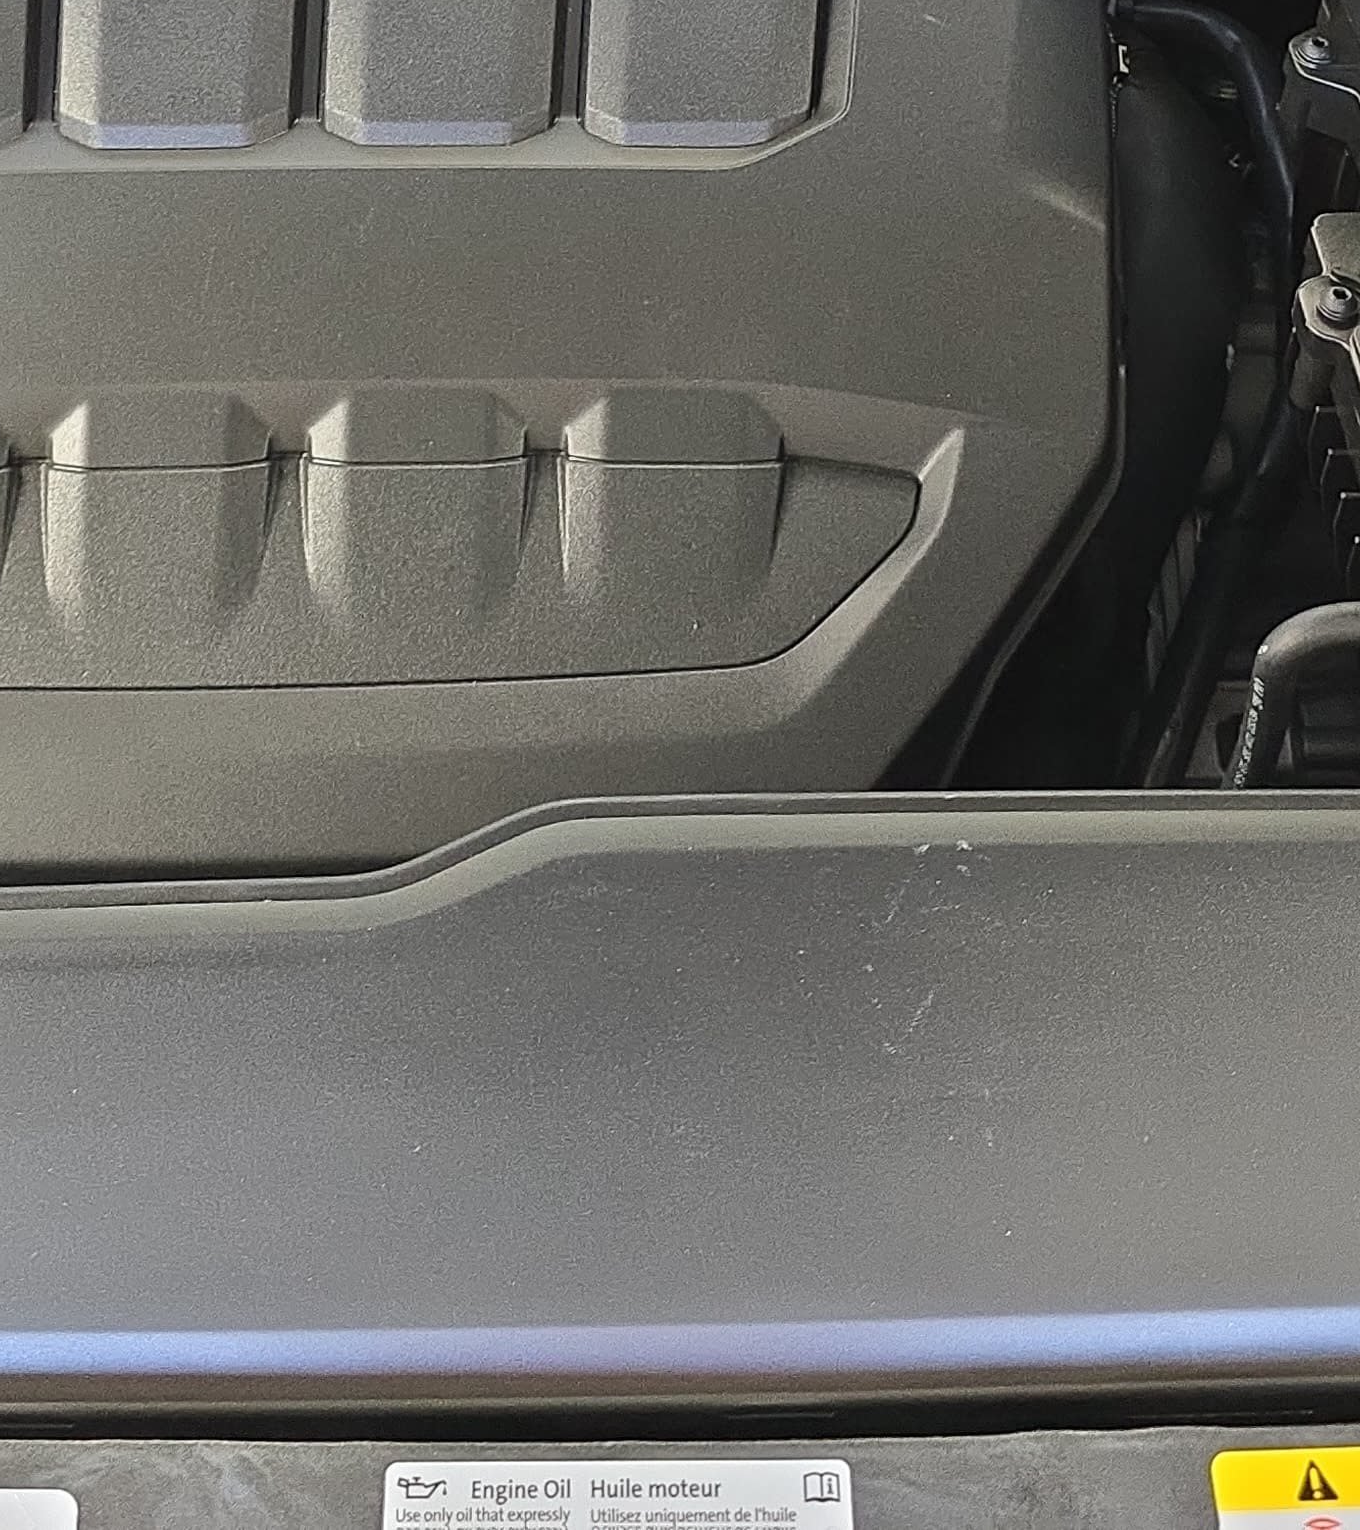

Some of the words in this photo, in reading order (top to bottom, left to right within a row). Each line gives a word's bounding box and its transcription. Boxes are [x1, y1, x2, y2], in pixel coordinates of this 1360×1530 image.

[471, 1479, 538, 1505] Engine
[543, 1479, 571, 1499] Oil
[590, 1478, 643, 1498] Huile
[648, 1480, 723, 1498] moteur
[395, 1509, 422, 1522] Use
[424, 1508, 452, 1528] only
[456, 1508, 473, 1522] oil
[475, 1508, 503, 1522] that
[507, 1507, 572, 1528] expressly
[590, 1508, 641, 1523] Utilisez
[645, 1508, 731, 1527] uniquement
[734, 1508, 751, 1522] de
[754, 1507, 797, 1522] l'huile
